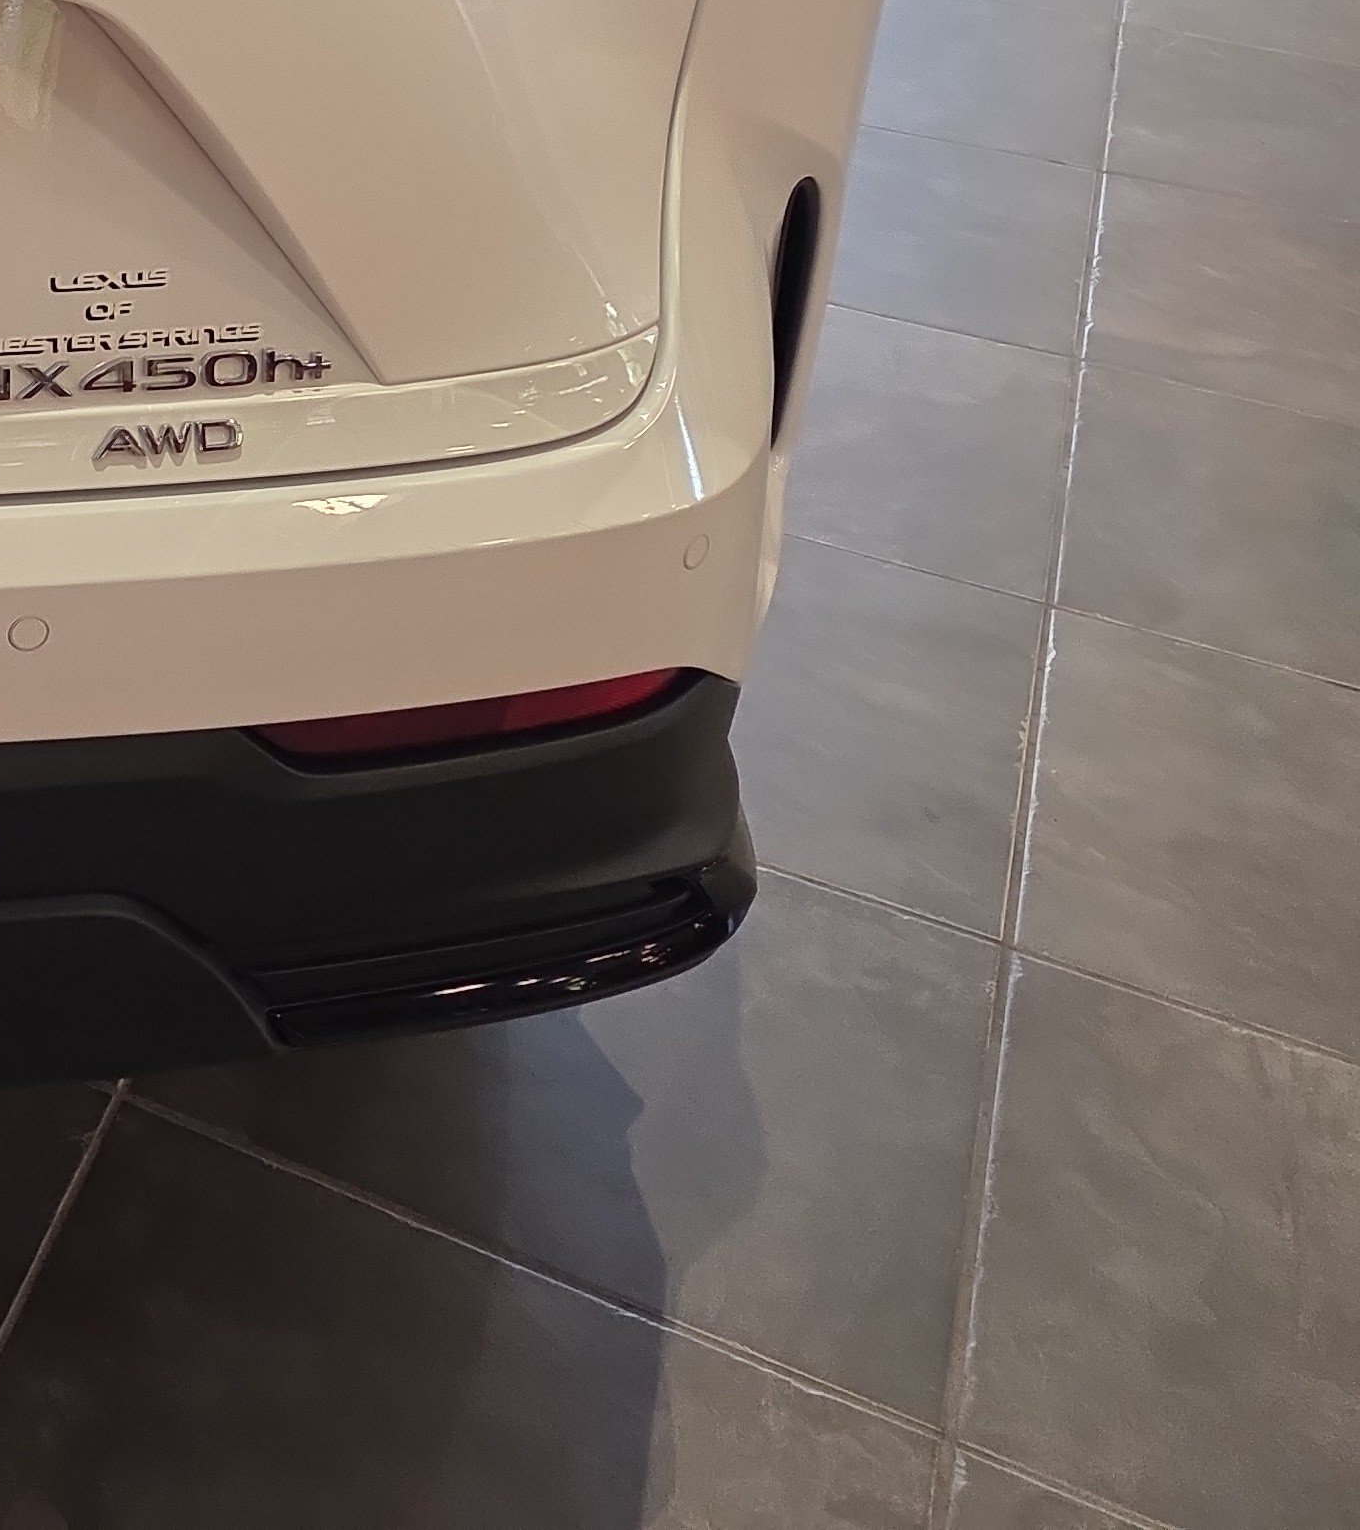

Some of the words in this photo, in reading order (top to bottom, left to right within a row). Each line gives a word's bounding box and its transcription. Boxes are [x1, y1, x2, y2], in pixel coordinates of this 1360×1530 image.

[49, 271, 168, 293] LEXUS
[84, 302, 132, 321] OF
[117, 325, 261, 351] SPRINGS
[93, 418, 244, 462] AWD
